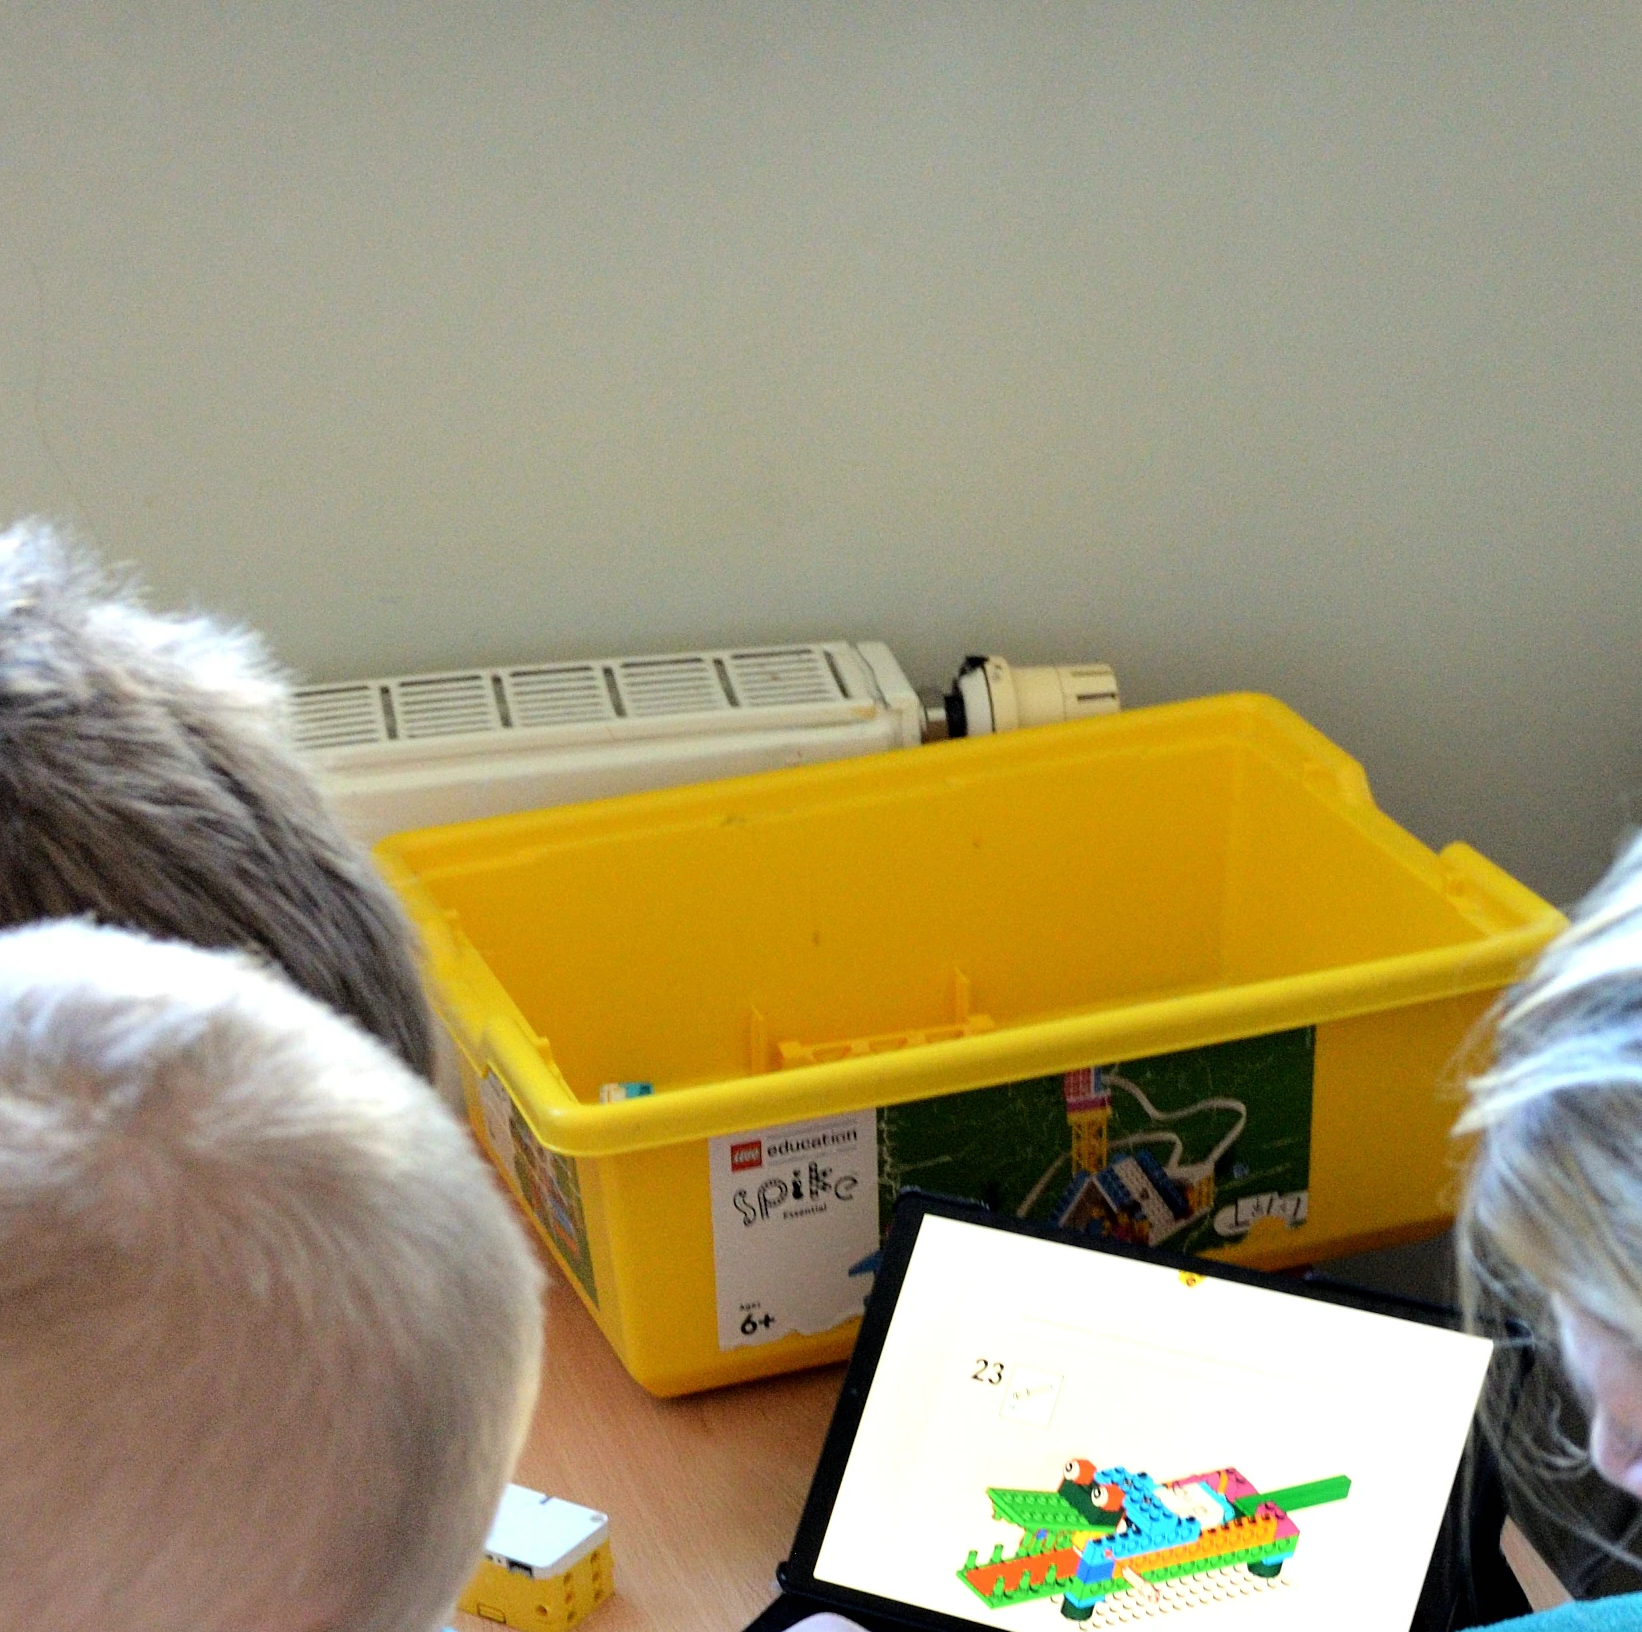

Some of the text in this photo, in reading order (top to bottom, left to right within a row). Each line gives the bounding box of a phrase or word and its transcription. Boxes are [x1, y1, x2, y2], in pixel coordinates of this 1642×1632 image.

[767, 1130, 857, 1157] education
[741, 1312, 775, 1335] 6+
[971, 1358, 1004, 1386] 23
